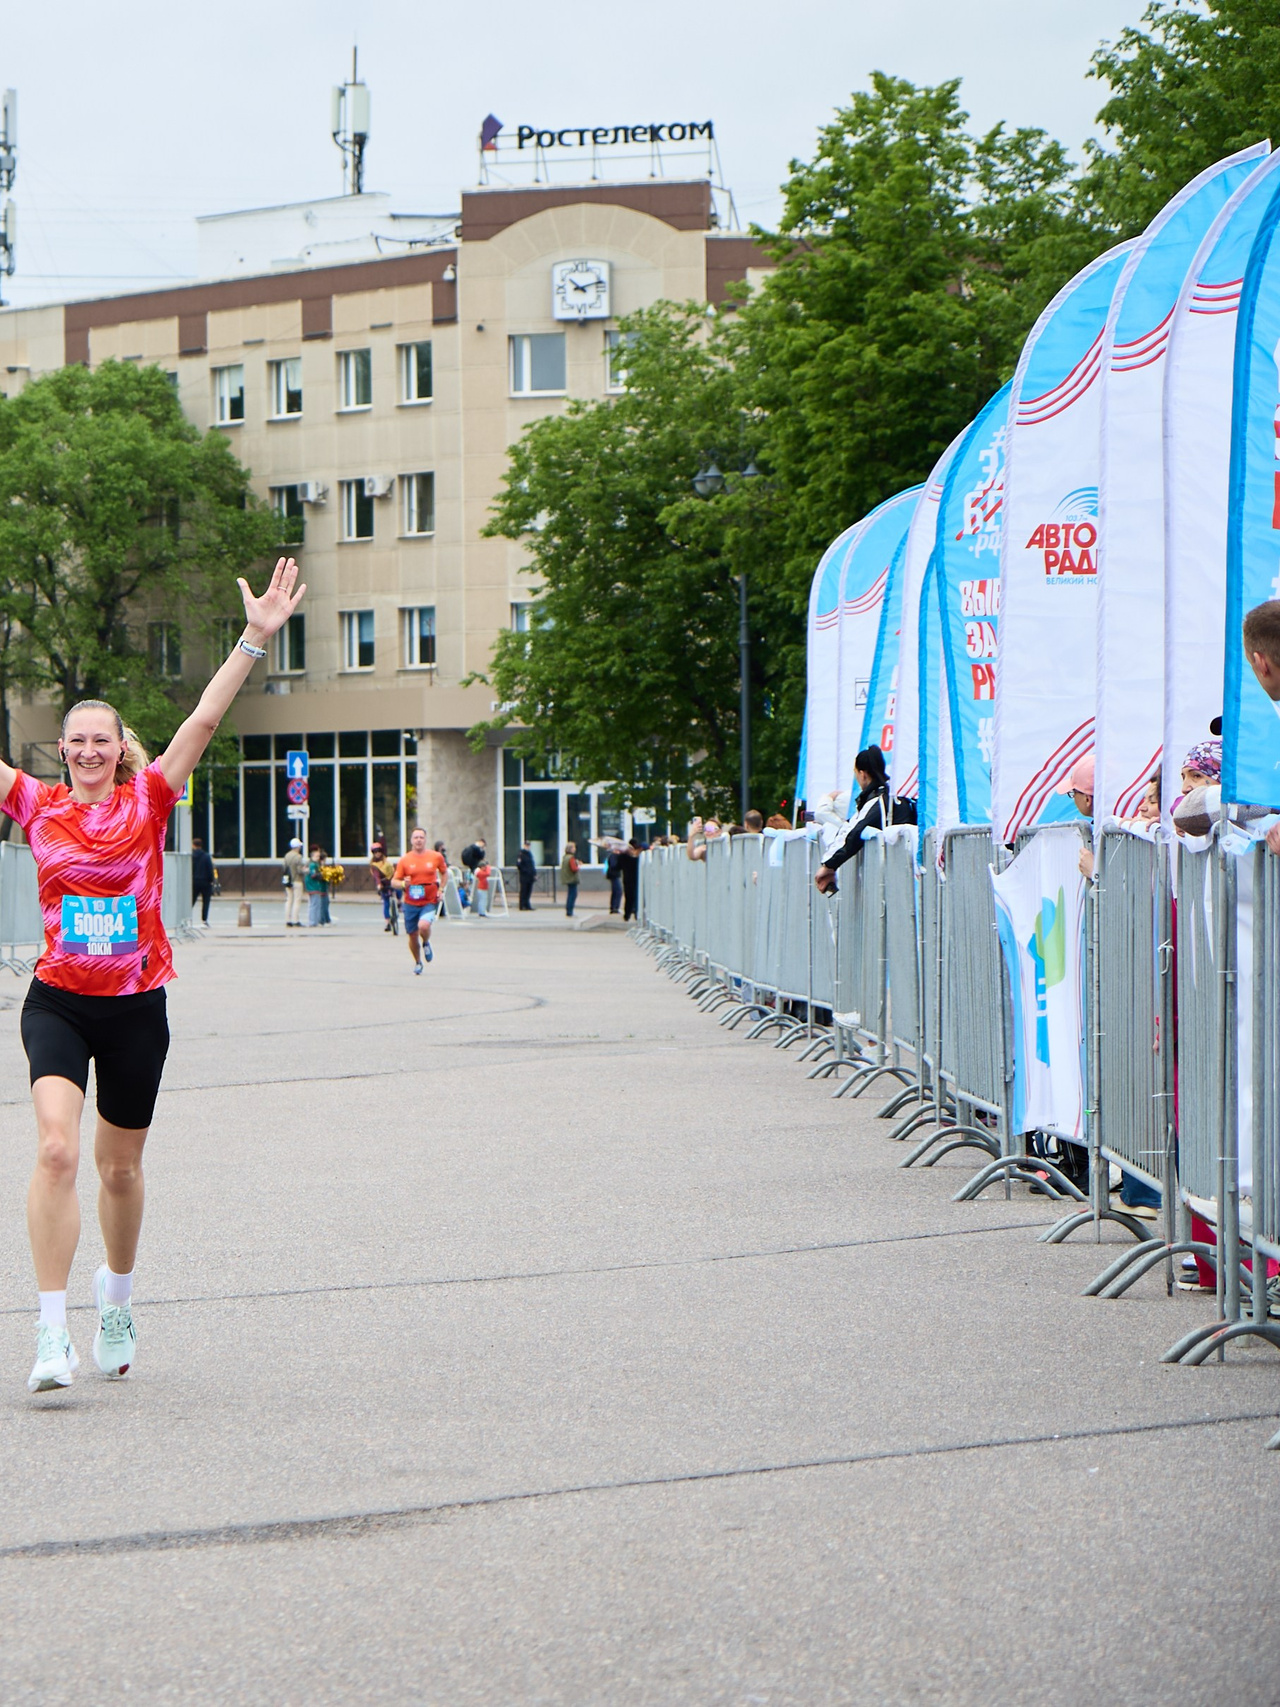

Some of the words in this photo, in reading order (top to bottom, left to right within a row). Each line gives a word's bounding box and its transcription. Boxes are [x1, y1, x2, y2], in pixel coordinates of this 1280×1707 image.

[518, 121, 713, 149] Ростелеком
[1024, 522, 1098, 549] АВТО
[1044, 548, 1098, 575] РАД
[74, 913, 124, 936] 50084
